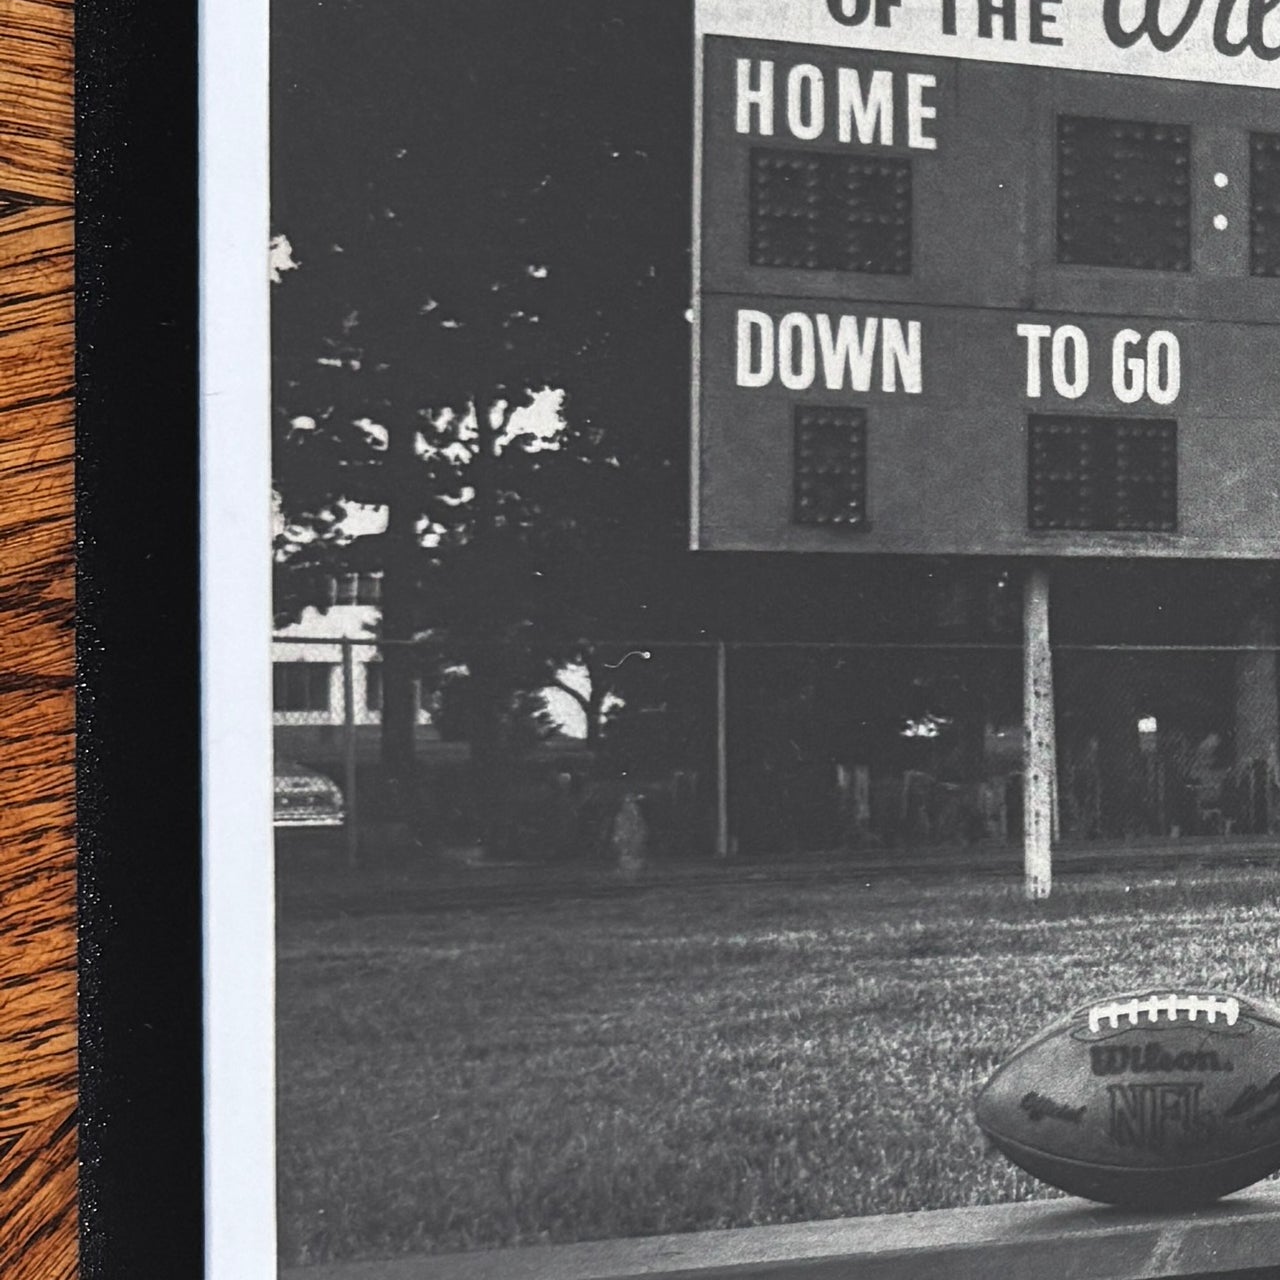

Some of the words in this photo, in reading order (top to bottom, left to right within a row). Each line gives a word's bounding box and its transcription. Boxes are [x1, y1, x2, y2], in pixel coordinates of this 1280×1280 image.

[737, 58, 938, 150] HOME
[737, 310, 921, 393] DOWN
[1017, 324, 1088, 398] TO
[1113, 329, 1180, 404] GO
[1107, 1081, 1214, 1151] NFL
